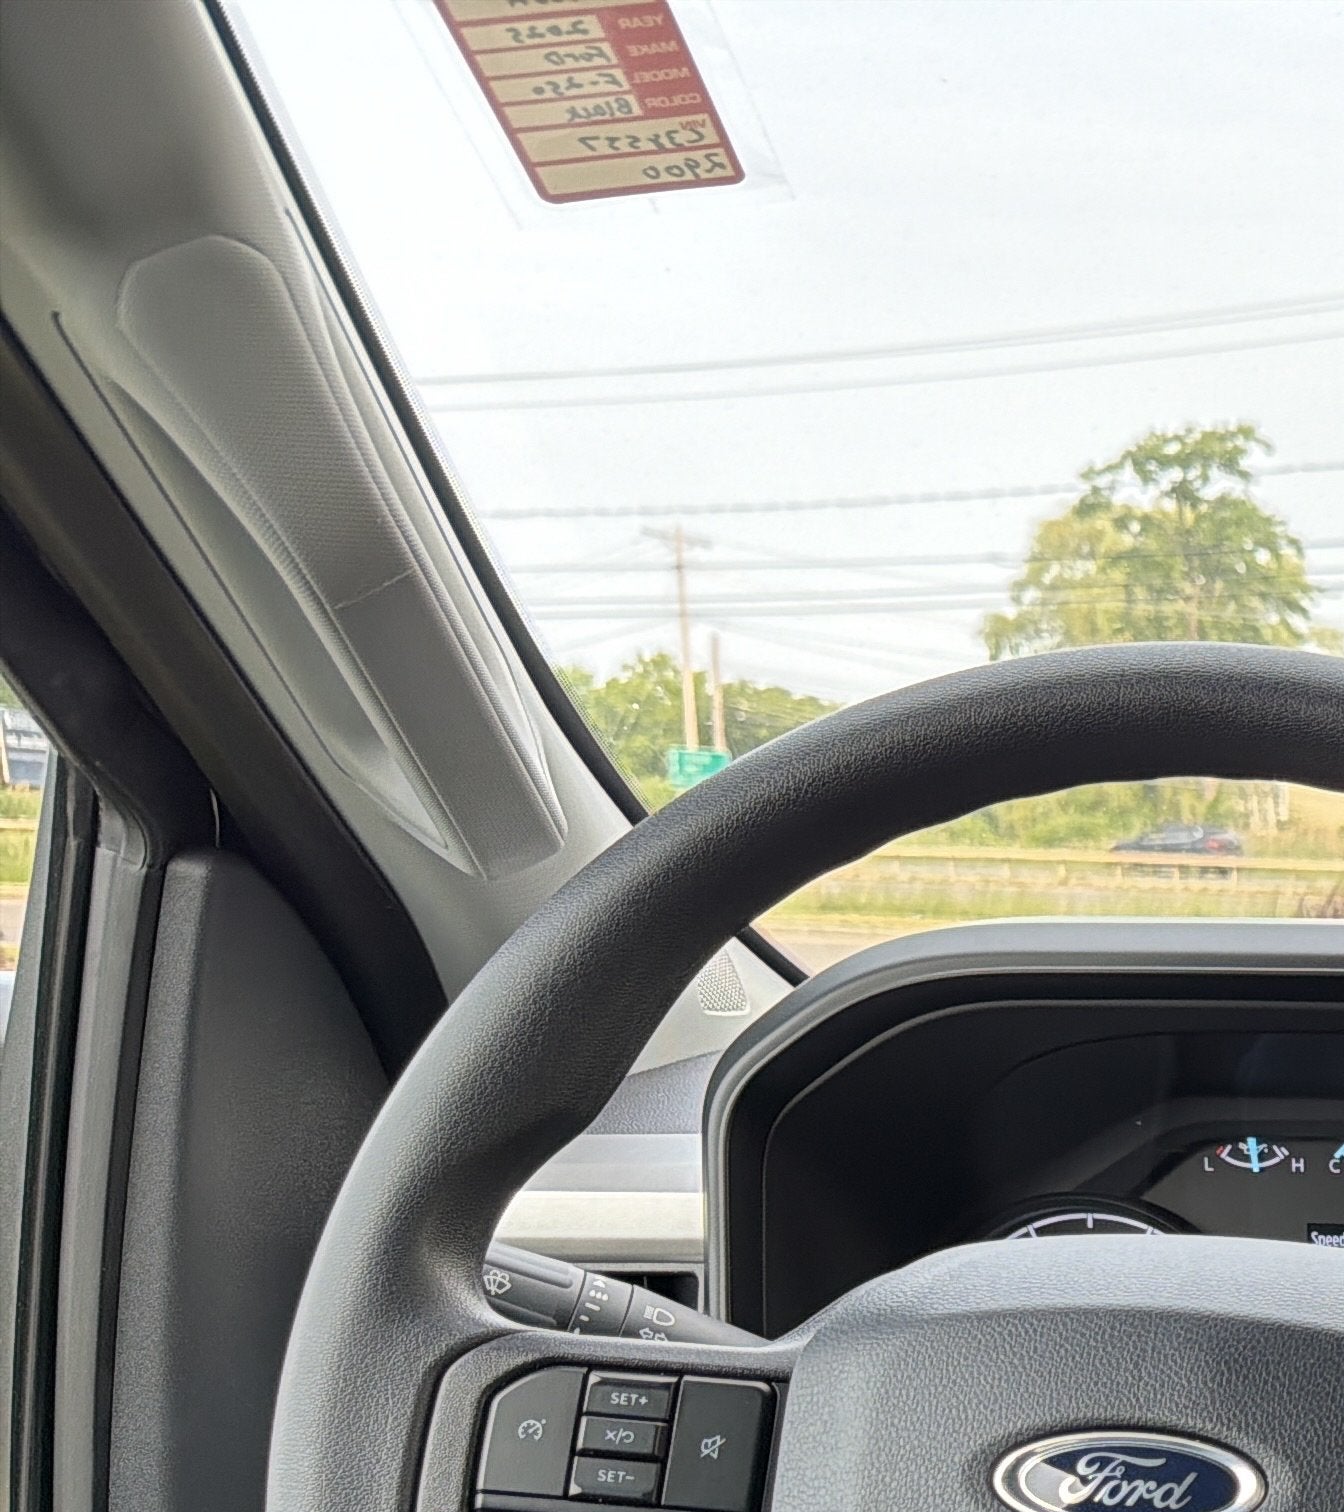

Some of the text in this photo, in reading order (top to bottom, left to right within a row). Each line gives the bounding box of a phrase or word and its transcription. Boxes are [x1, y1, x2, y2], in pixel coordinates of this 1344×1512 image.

[1204, 1158, 1214, 1172] L
[1291, 1158, 1305, 1173] H
[1329, 1160, 1341, 1174] C
[1058, 1451, 1198, 1509] Ford
